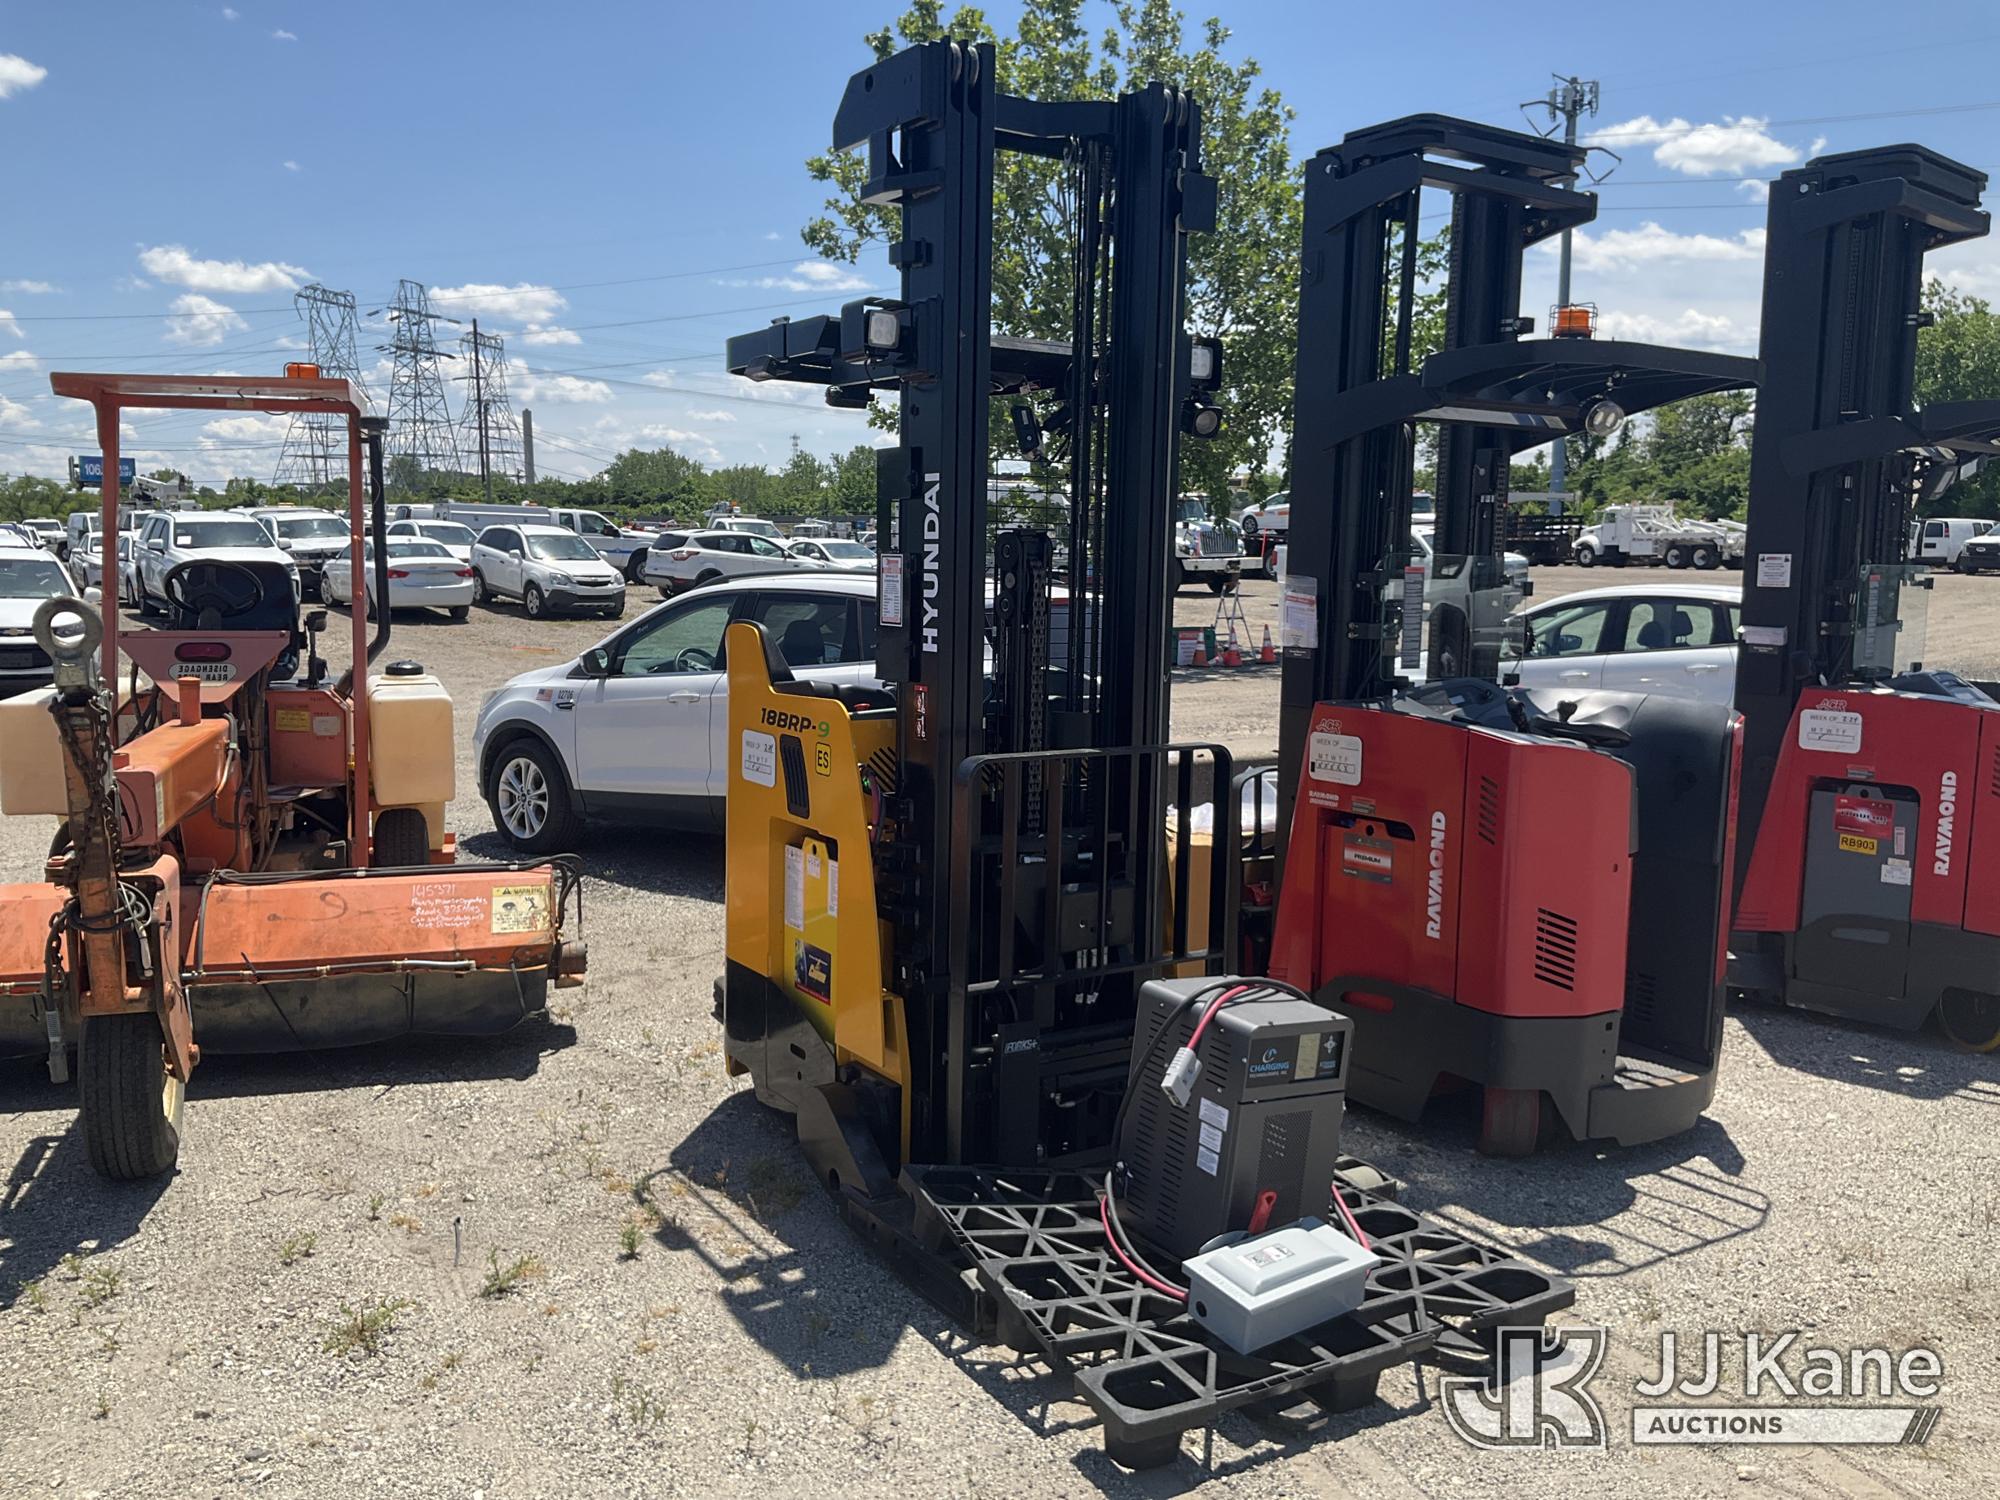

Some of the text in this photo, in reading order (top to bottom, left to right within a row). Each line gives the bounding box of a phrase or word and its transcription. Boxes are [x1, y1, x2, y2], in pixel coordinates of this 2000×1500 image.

[922, 472, 940, 653] HYUNDAI
[761, 707, 831, 737] 18BRP-9
[817, 750, 829, 769] ES
[1934, 771, 1957, 876] RAYMOND
[1840, 836, 1876, 850] RB903
[1426, 811, 1446, 940] RAYMOND
[1249, 1060, 1290, 1073] CHARGING
